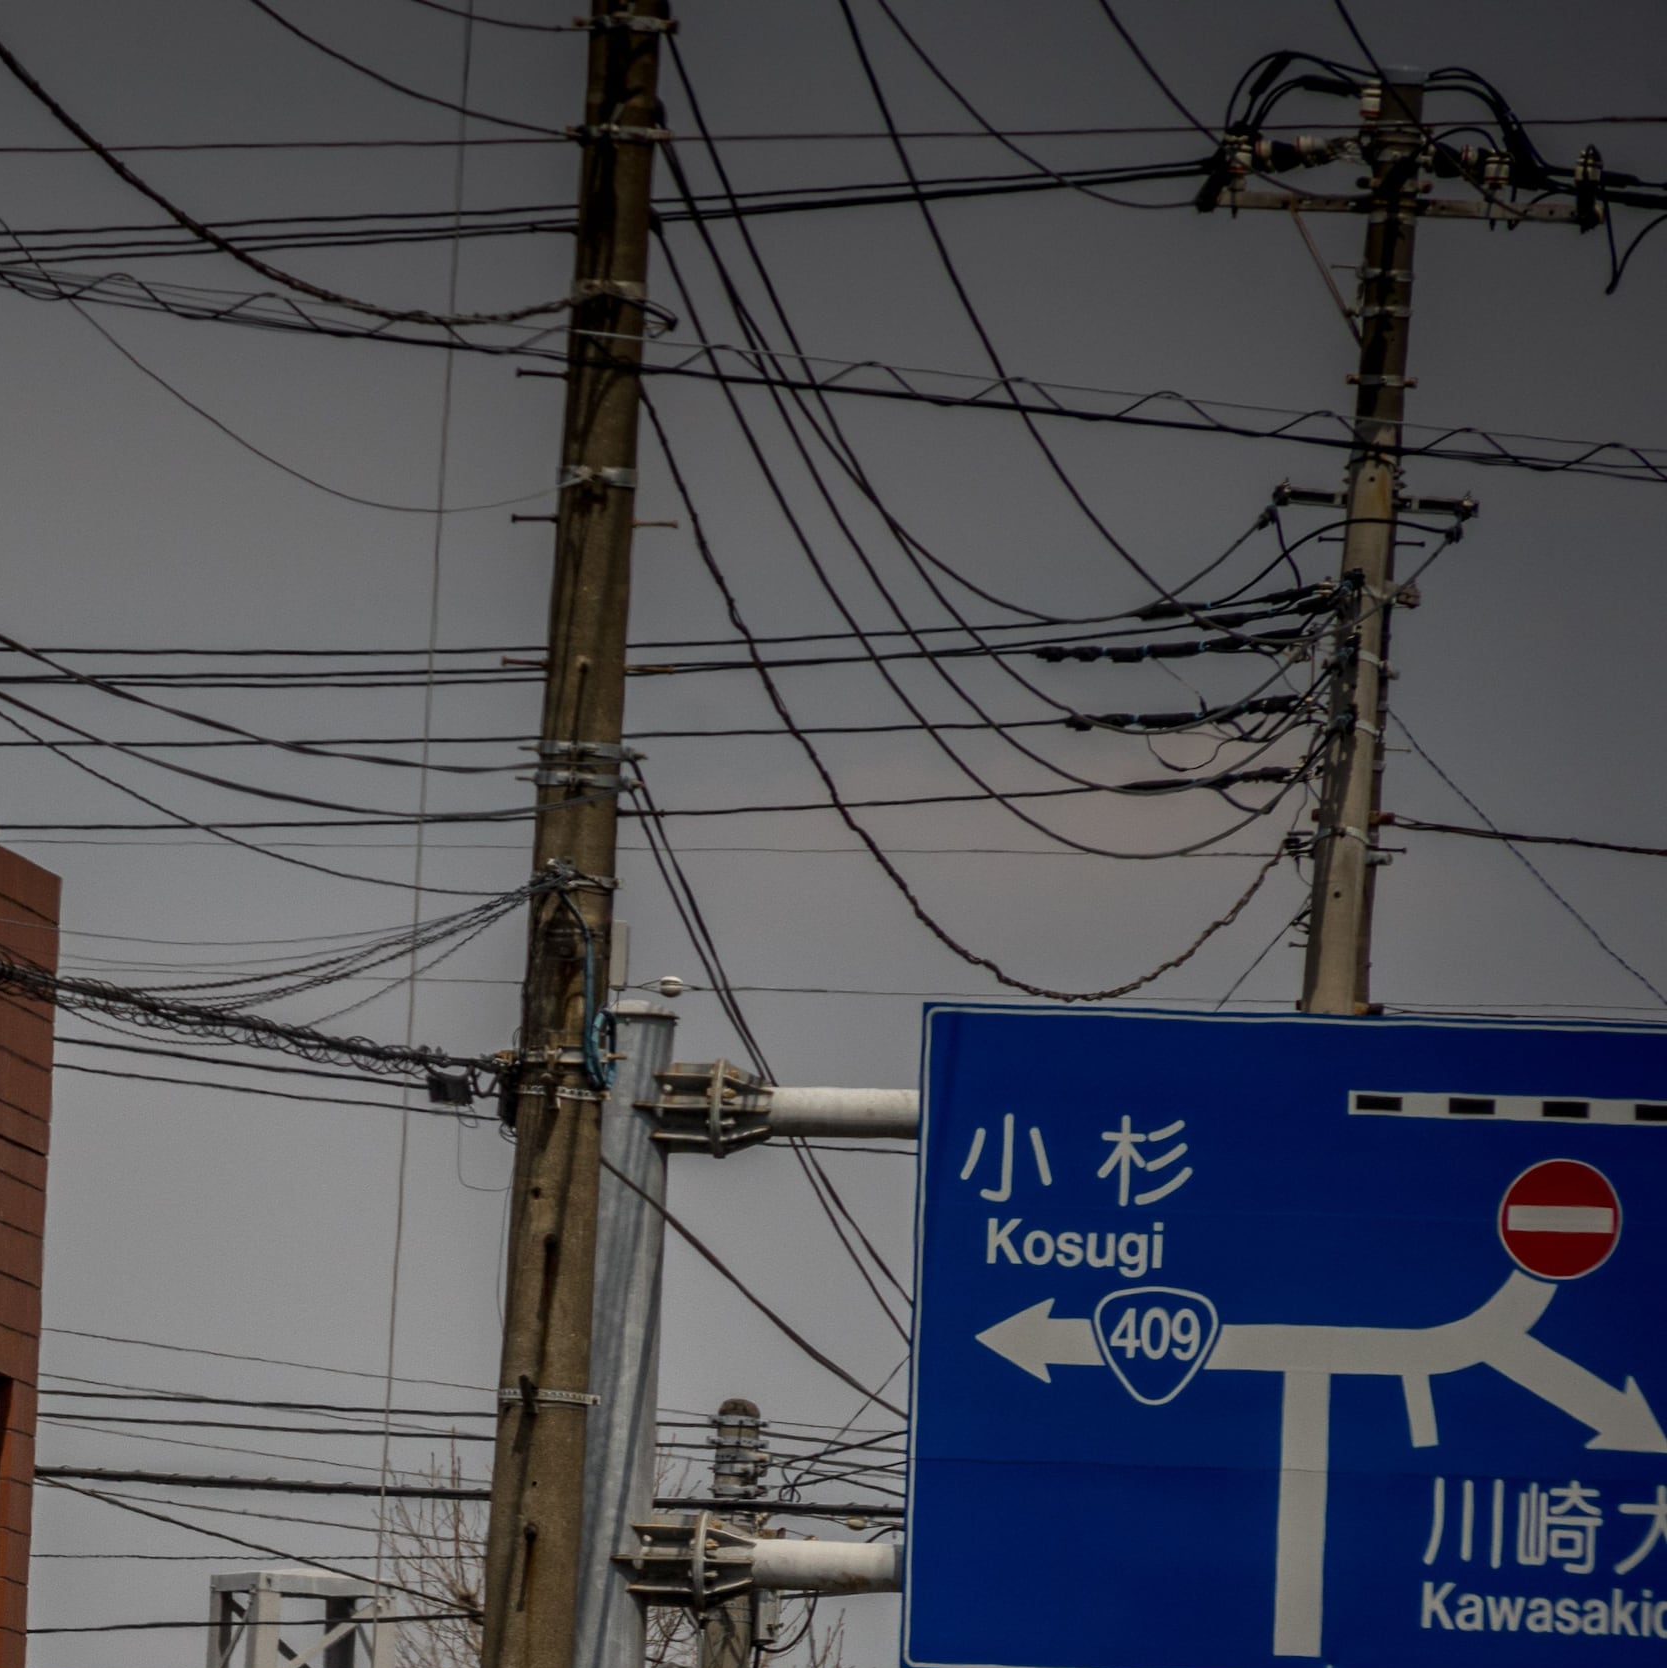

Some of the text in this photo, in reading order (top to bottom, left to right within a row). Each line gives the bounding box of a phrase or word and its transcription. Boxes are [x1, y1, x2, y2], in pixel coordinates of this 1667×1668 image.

[960, 1112, 1194, 1207] 小杉
[986, 1217, 1164, 1278] Kosugi
[1109, 1306, 1201, 1361] 409
